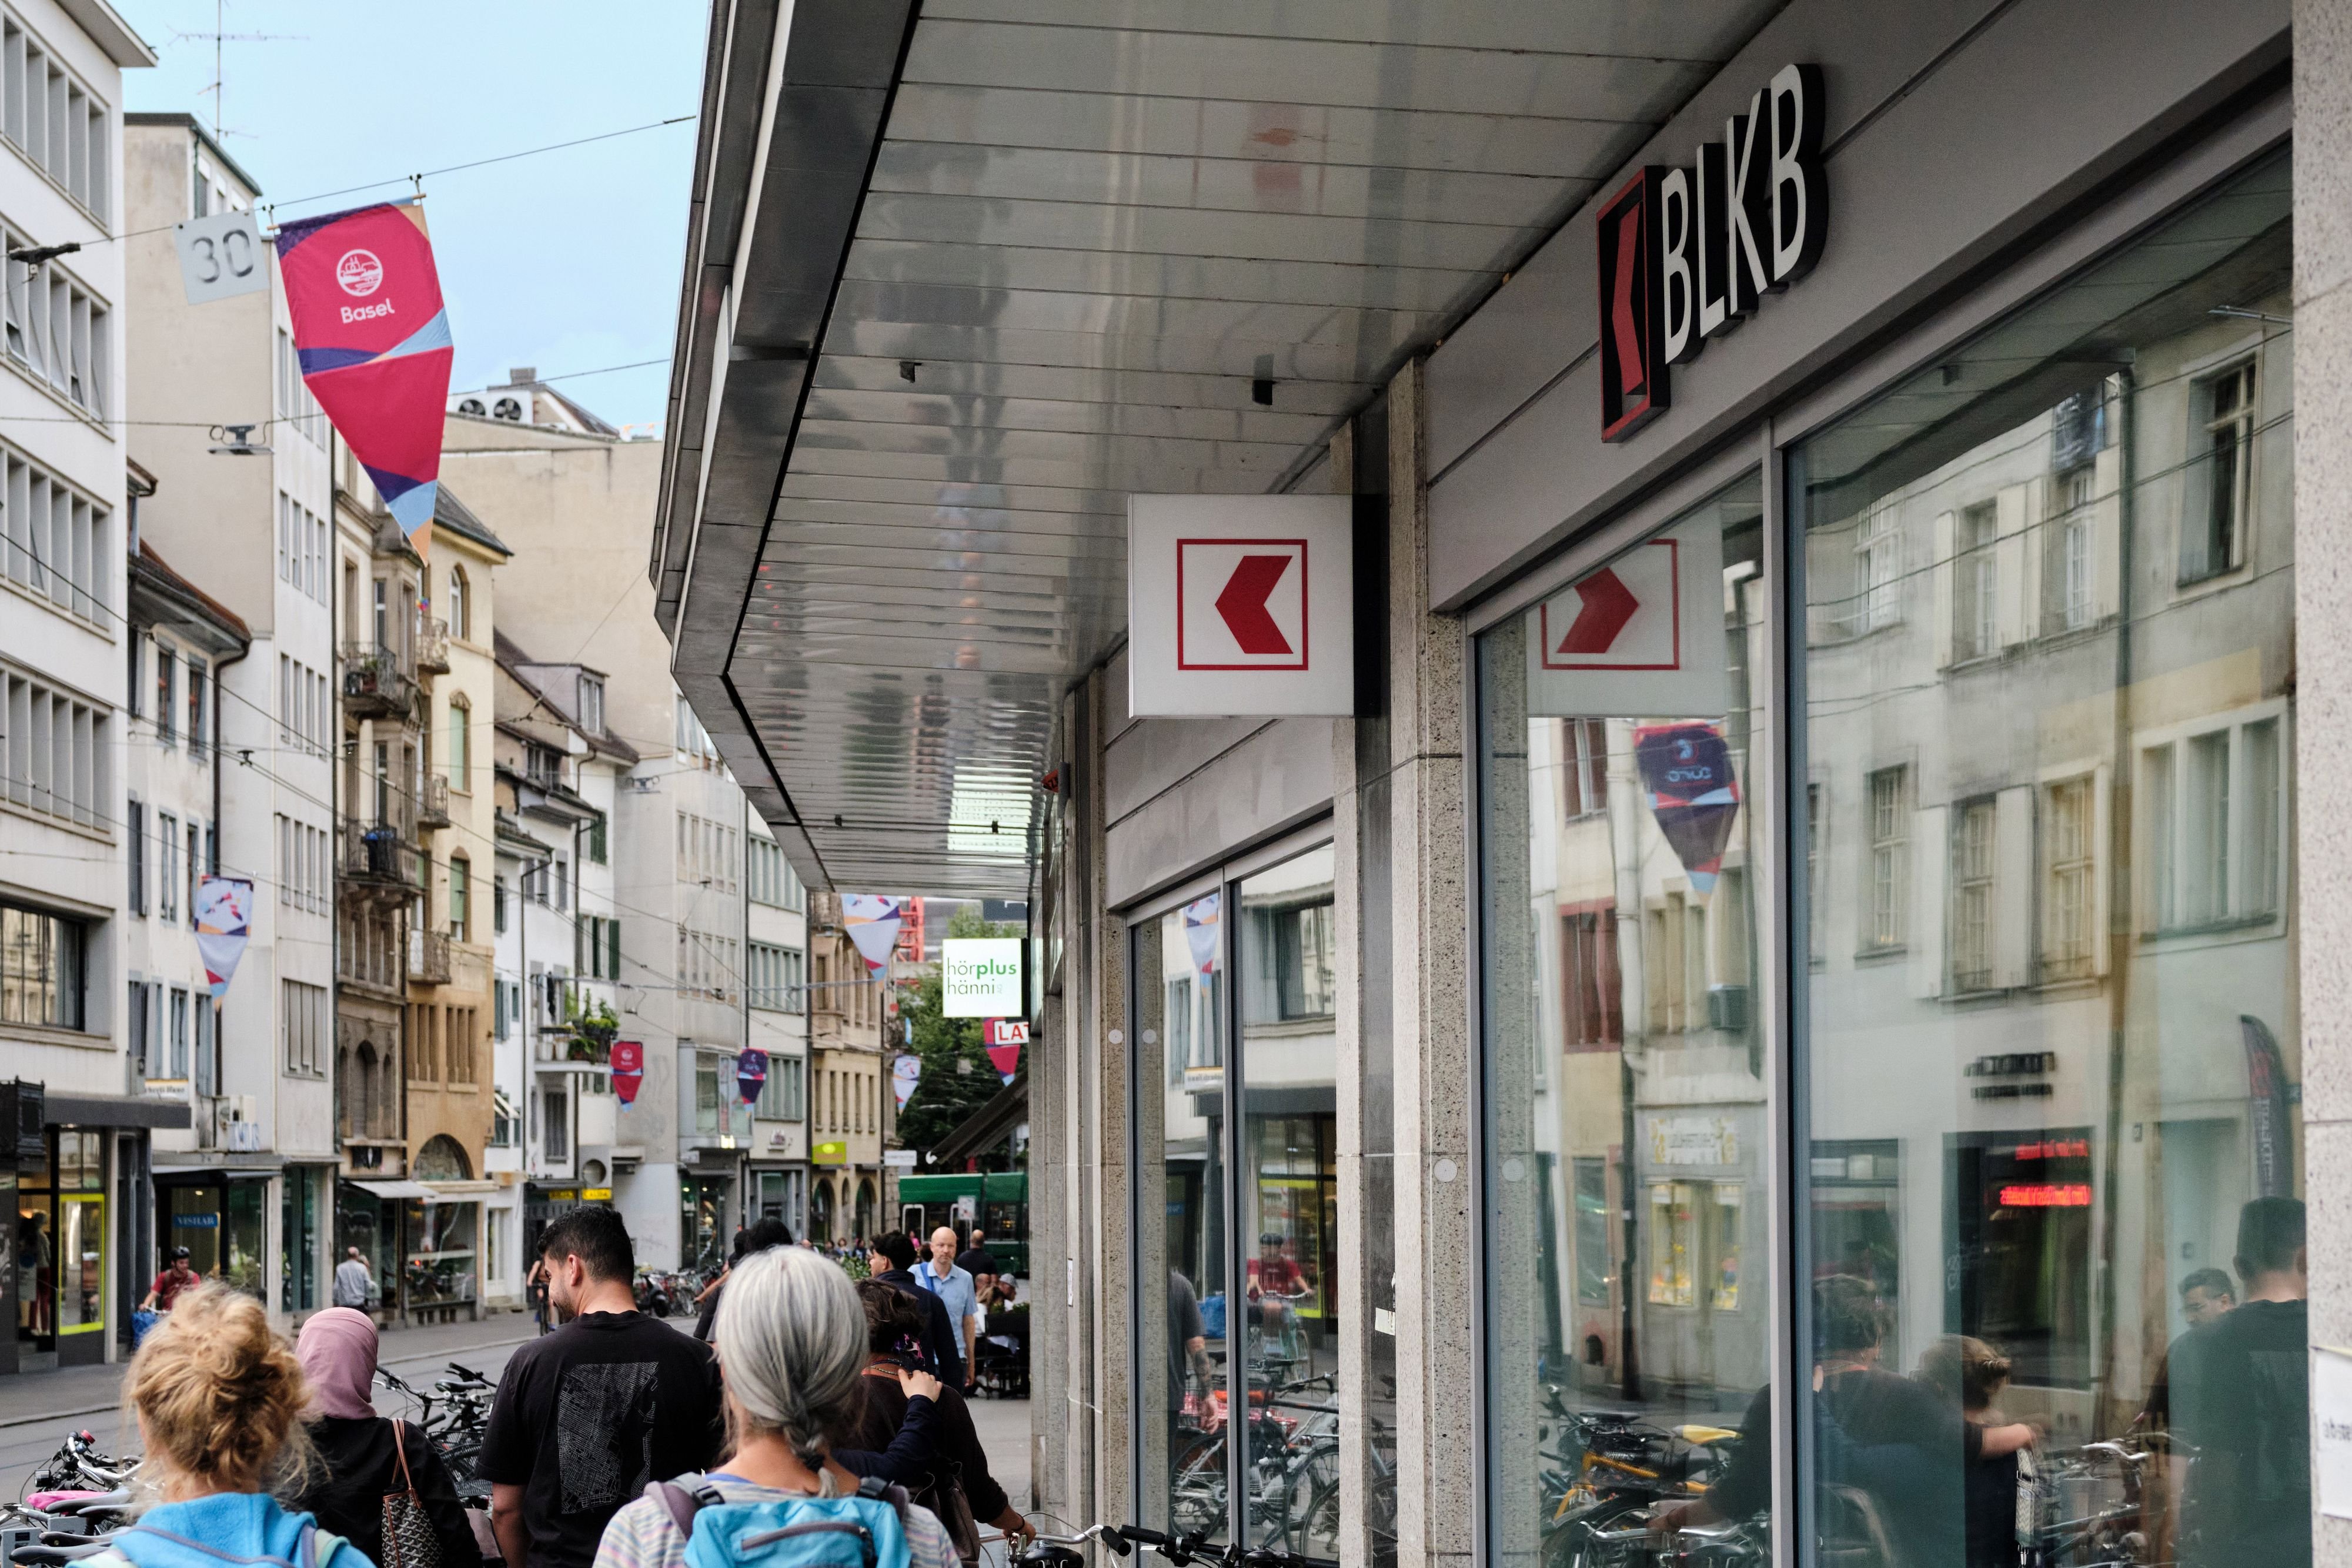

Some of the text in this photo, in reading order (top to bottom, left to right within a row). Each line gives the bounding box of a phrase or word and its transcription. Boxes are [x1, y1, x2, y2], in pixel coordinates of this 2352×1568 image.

[1662, 63, 1808, 365] BLKB
[192, 228, 254, 284] 30
[340, 297, 396, 324] Basel
[947, 957, 1017, 980] hörplus
[947, 976, 995, 995] hänni
[998, 1024, 1029, 1041] LA
